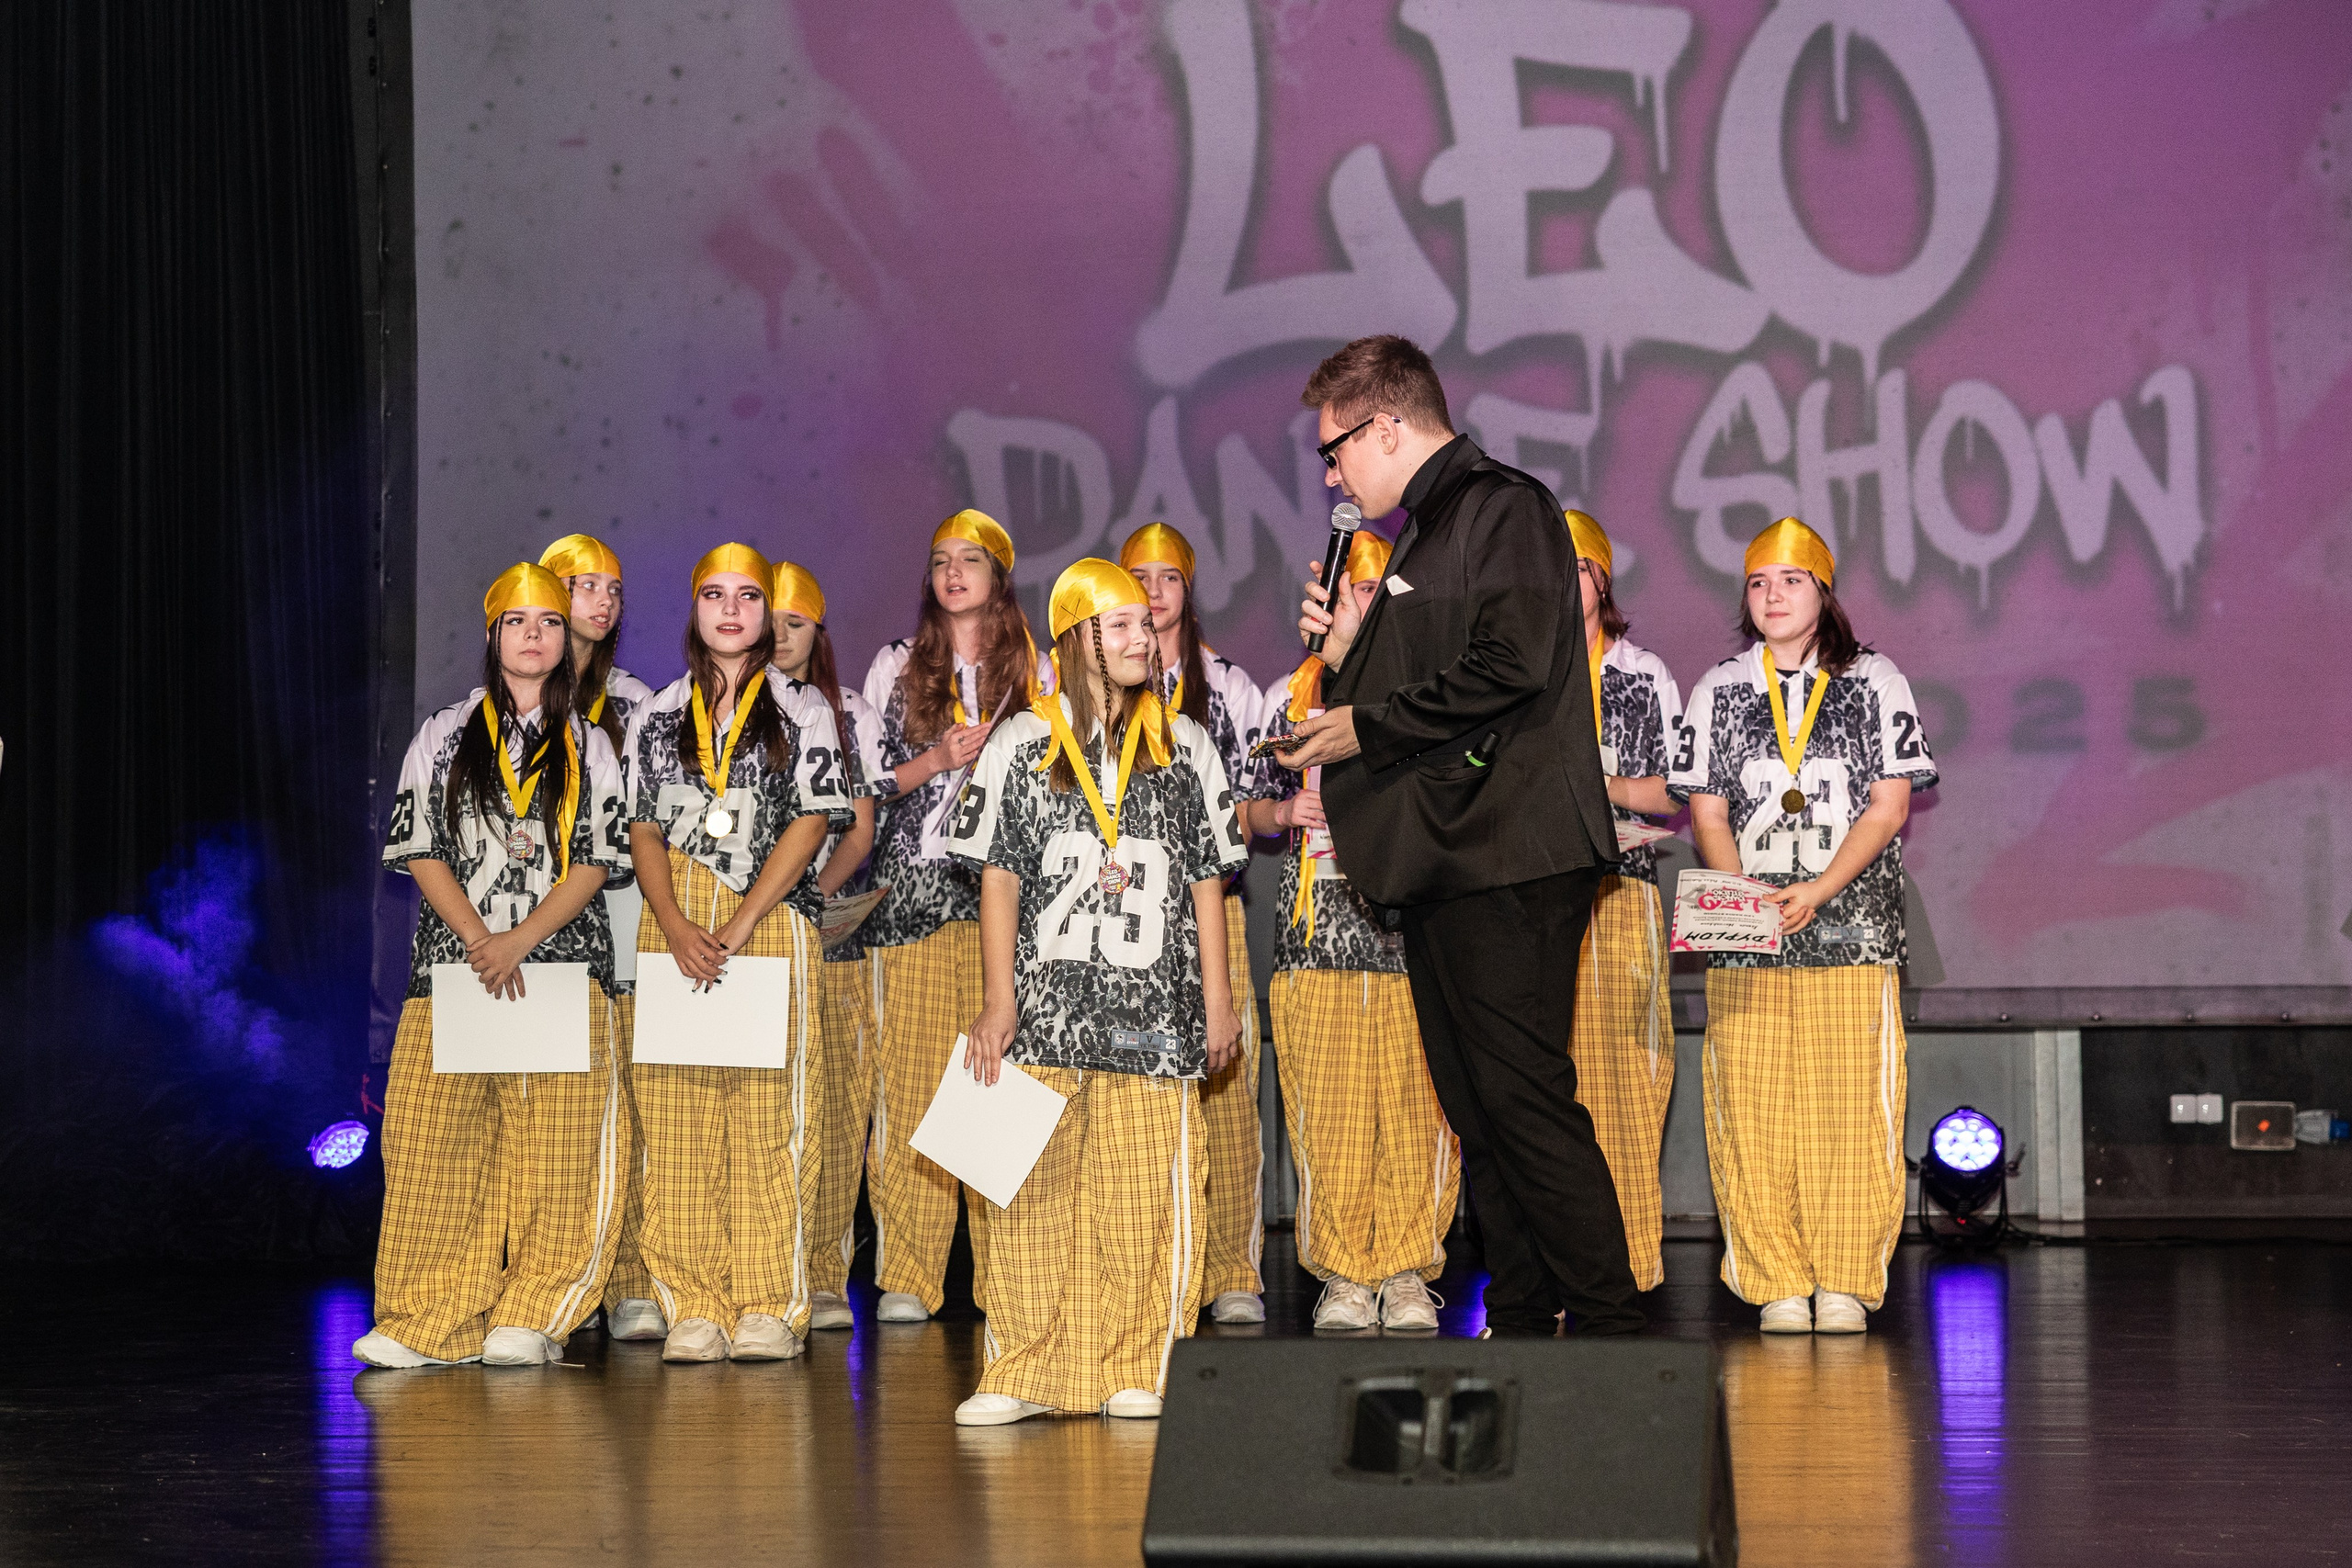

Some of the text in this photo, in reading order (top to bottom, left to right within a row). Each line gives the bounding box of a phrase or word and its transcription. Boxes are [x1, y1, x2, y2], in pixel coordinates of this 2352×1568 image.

[1136, 0, 2000, 386] LEO
[946, 361, 2205, 617] DANE SHOW
[806, 747, 850, 799] 23
[385, 788, 414, 845] 23
[1739, 759, 1849, 874] 23
[1038, 831, 1170, 969] 23
[1683, 931, 1770, 942] DYPLOM
[1165, 1038, 1177, 1050] 23
